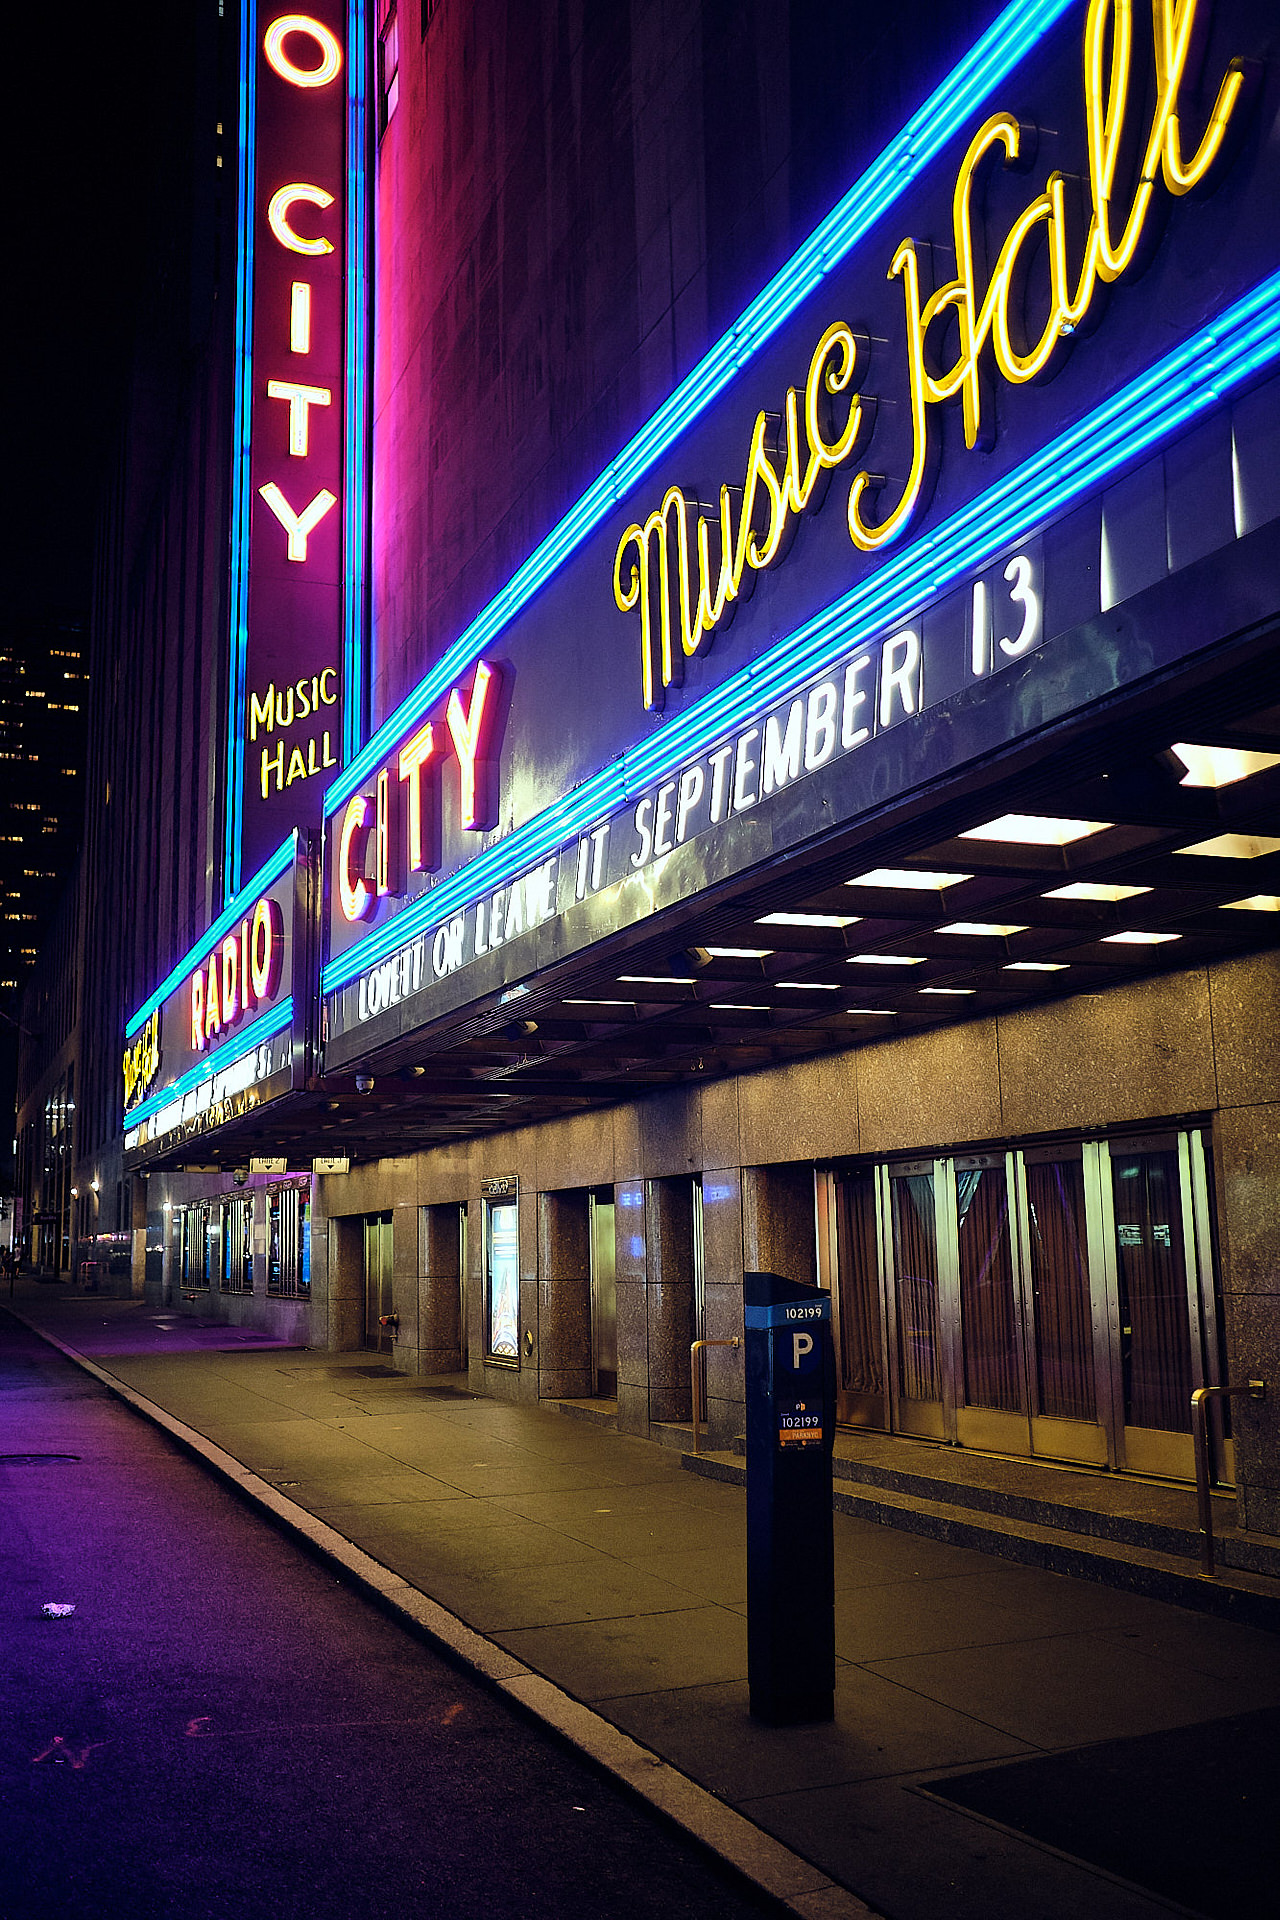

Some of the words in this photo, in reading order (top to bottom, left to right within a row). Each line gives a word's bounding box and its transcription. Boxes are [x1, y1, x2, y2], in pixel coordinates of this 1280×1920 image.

[257, 182, 338, 563] CITY
[613, 320, 862, 712] Music
[846, 0, 1246, 552] Hall
[249, 666, 338, 742] MUSIC
[260, 731, 338, 799] HALL
[432, 916, 465, 978] OR
[475, 857, 557, 956] LEAVE
[575, 824, 610, 900] IT
[630, 630, 920, 868] SEPTEMBER
[971, 555, 1040, 677] 13
[191, 898, 280, 1051] RADIO
[339, 658, 498, 922] CITY
[785, 1307, 822, 1320] 102199
[792, 1332, 814, 1369] P
[782, 1416, 819, 1428] 102199
